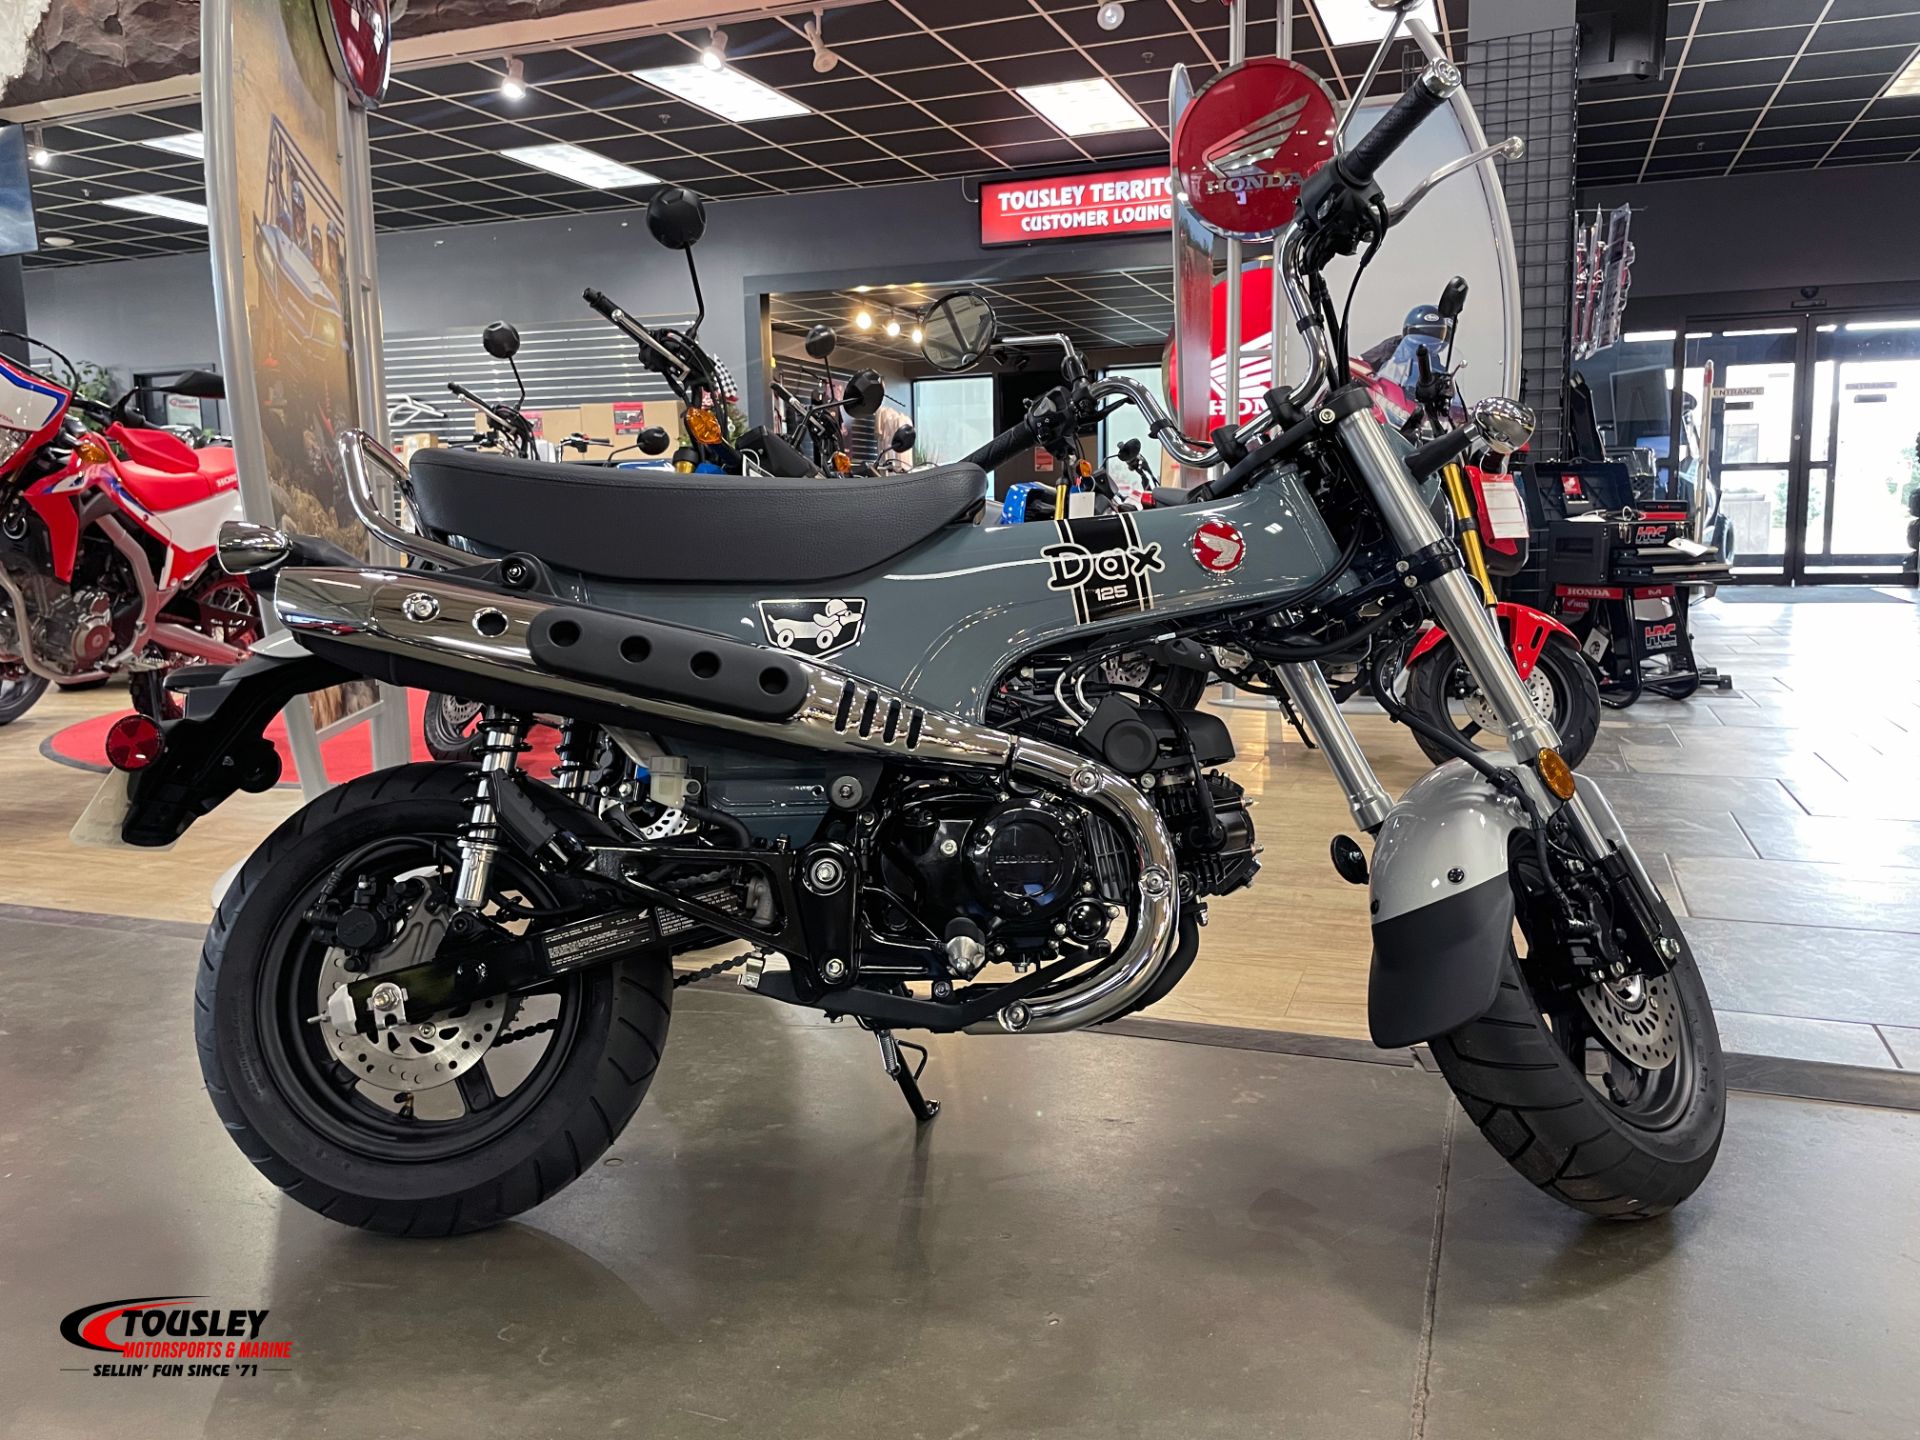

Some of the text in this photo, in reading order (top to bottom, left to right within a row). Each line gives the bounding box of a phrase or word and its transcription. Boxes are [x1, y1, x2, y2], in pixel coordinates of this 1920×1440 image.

[1206, 172, 1303, 195] HONDA
[997, 185, 1085, 211] TOUSLEY
[1021, 204, 1172, 232] CUSTOMER LOUNG
[1041, 542, 1165, 591] Dax
[1094, 584, 1128, 601] 125
[1567, 587, 1610, 597] HONDA
